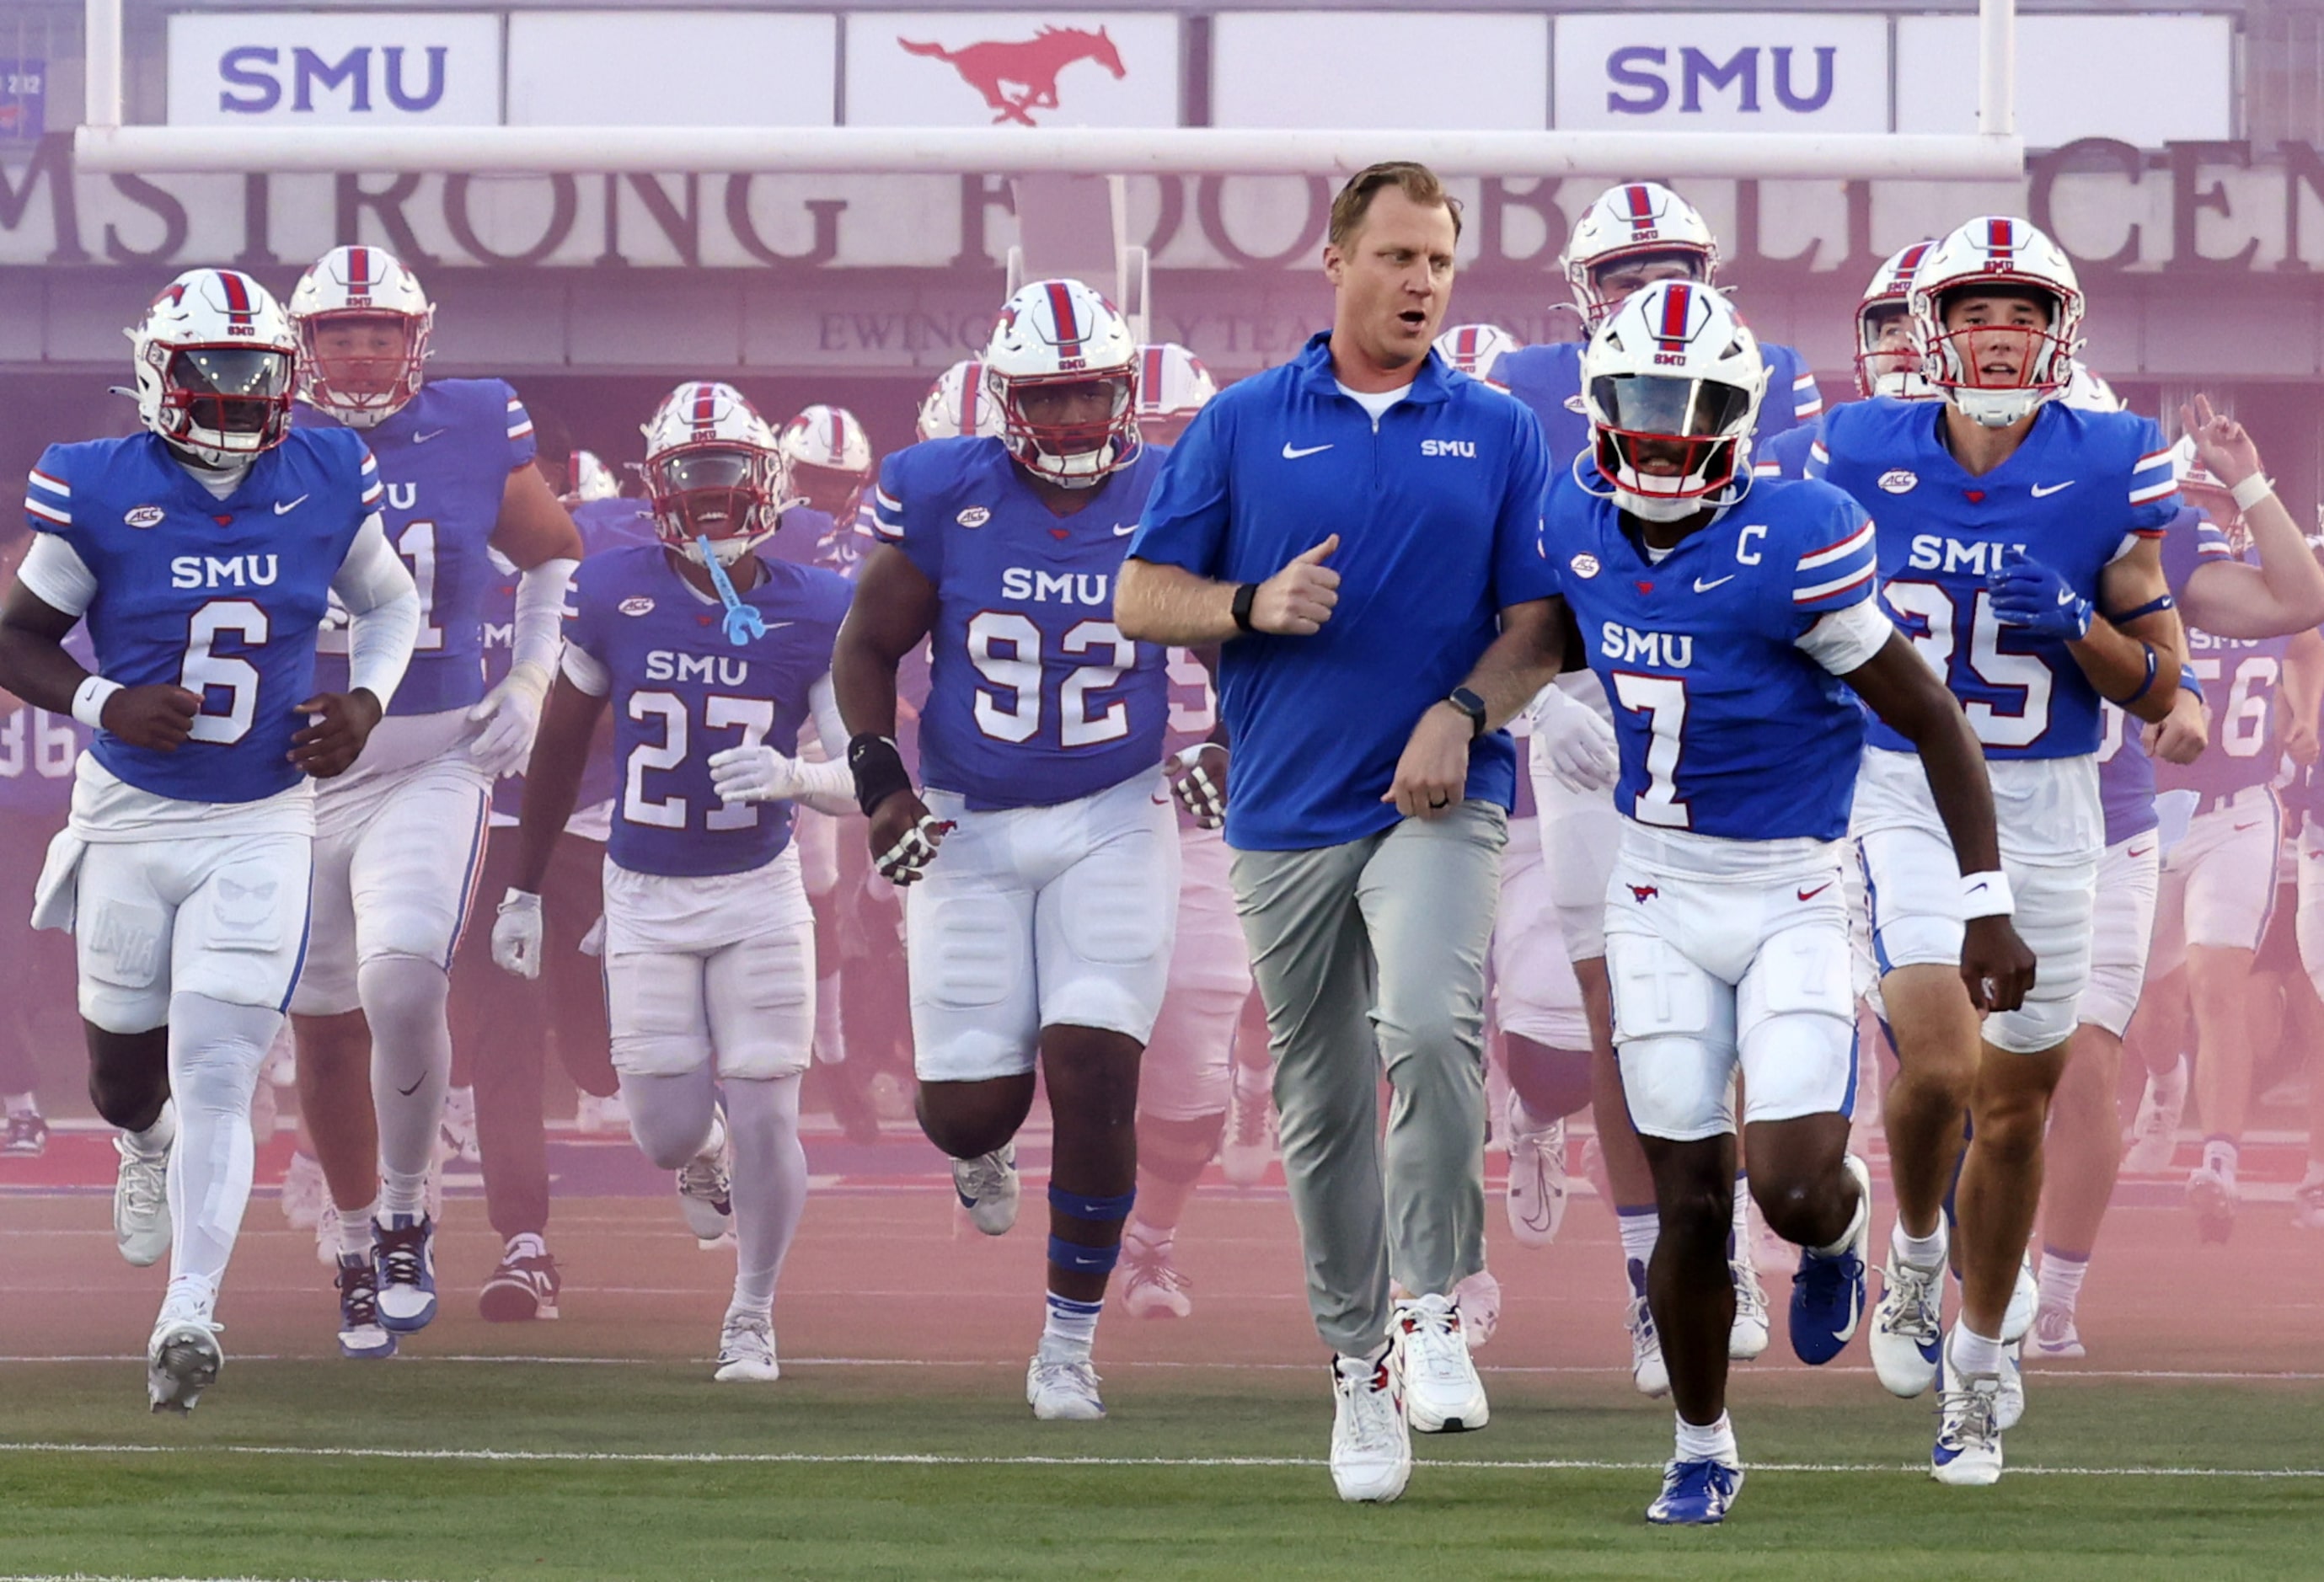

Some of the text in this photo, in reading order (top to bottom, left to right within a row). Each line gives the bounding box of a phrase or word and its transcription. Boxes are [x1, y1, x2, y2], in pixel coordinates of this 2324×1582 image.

[219, 46, 448, 113] SMU
[1605, 46, 1837, 114] SMU
[1421, 440, 1475, 457] SMU
[1880, 476, 1913, 489] ACC
[129, 507, 160, 522] ACC
[1736, 524, 1768, 565] C
[171, 554, 278, 589] SMU
[1001, 568, 1108, 605] SMU
[1601, 621, 1692, 668] SMU
[179, 598, 270, 746] 6
[645, 650, 748, 687] SMU
[966, 609, 1136, 749] 92
[623, 689, 774, 831] 27
[1612, 671, 1690, 829] 7
